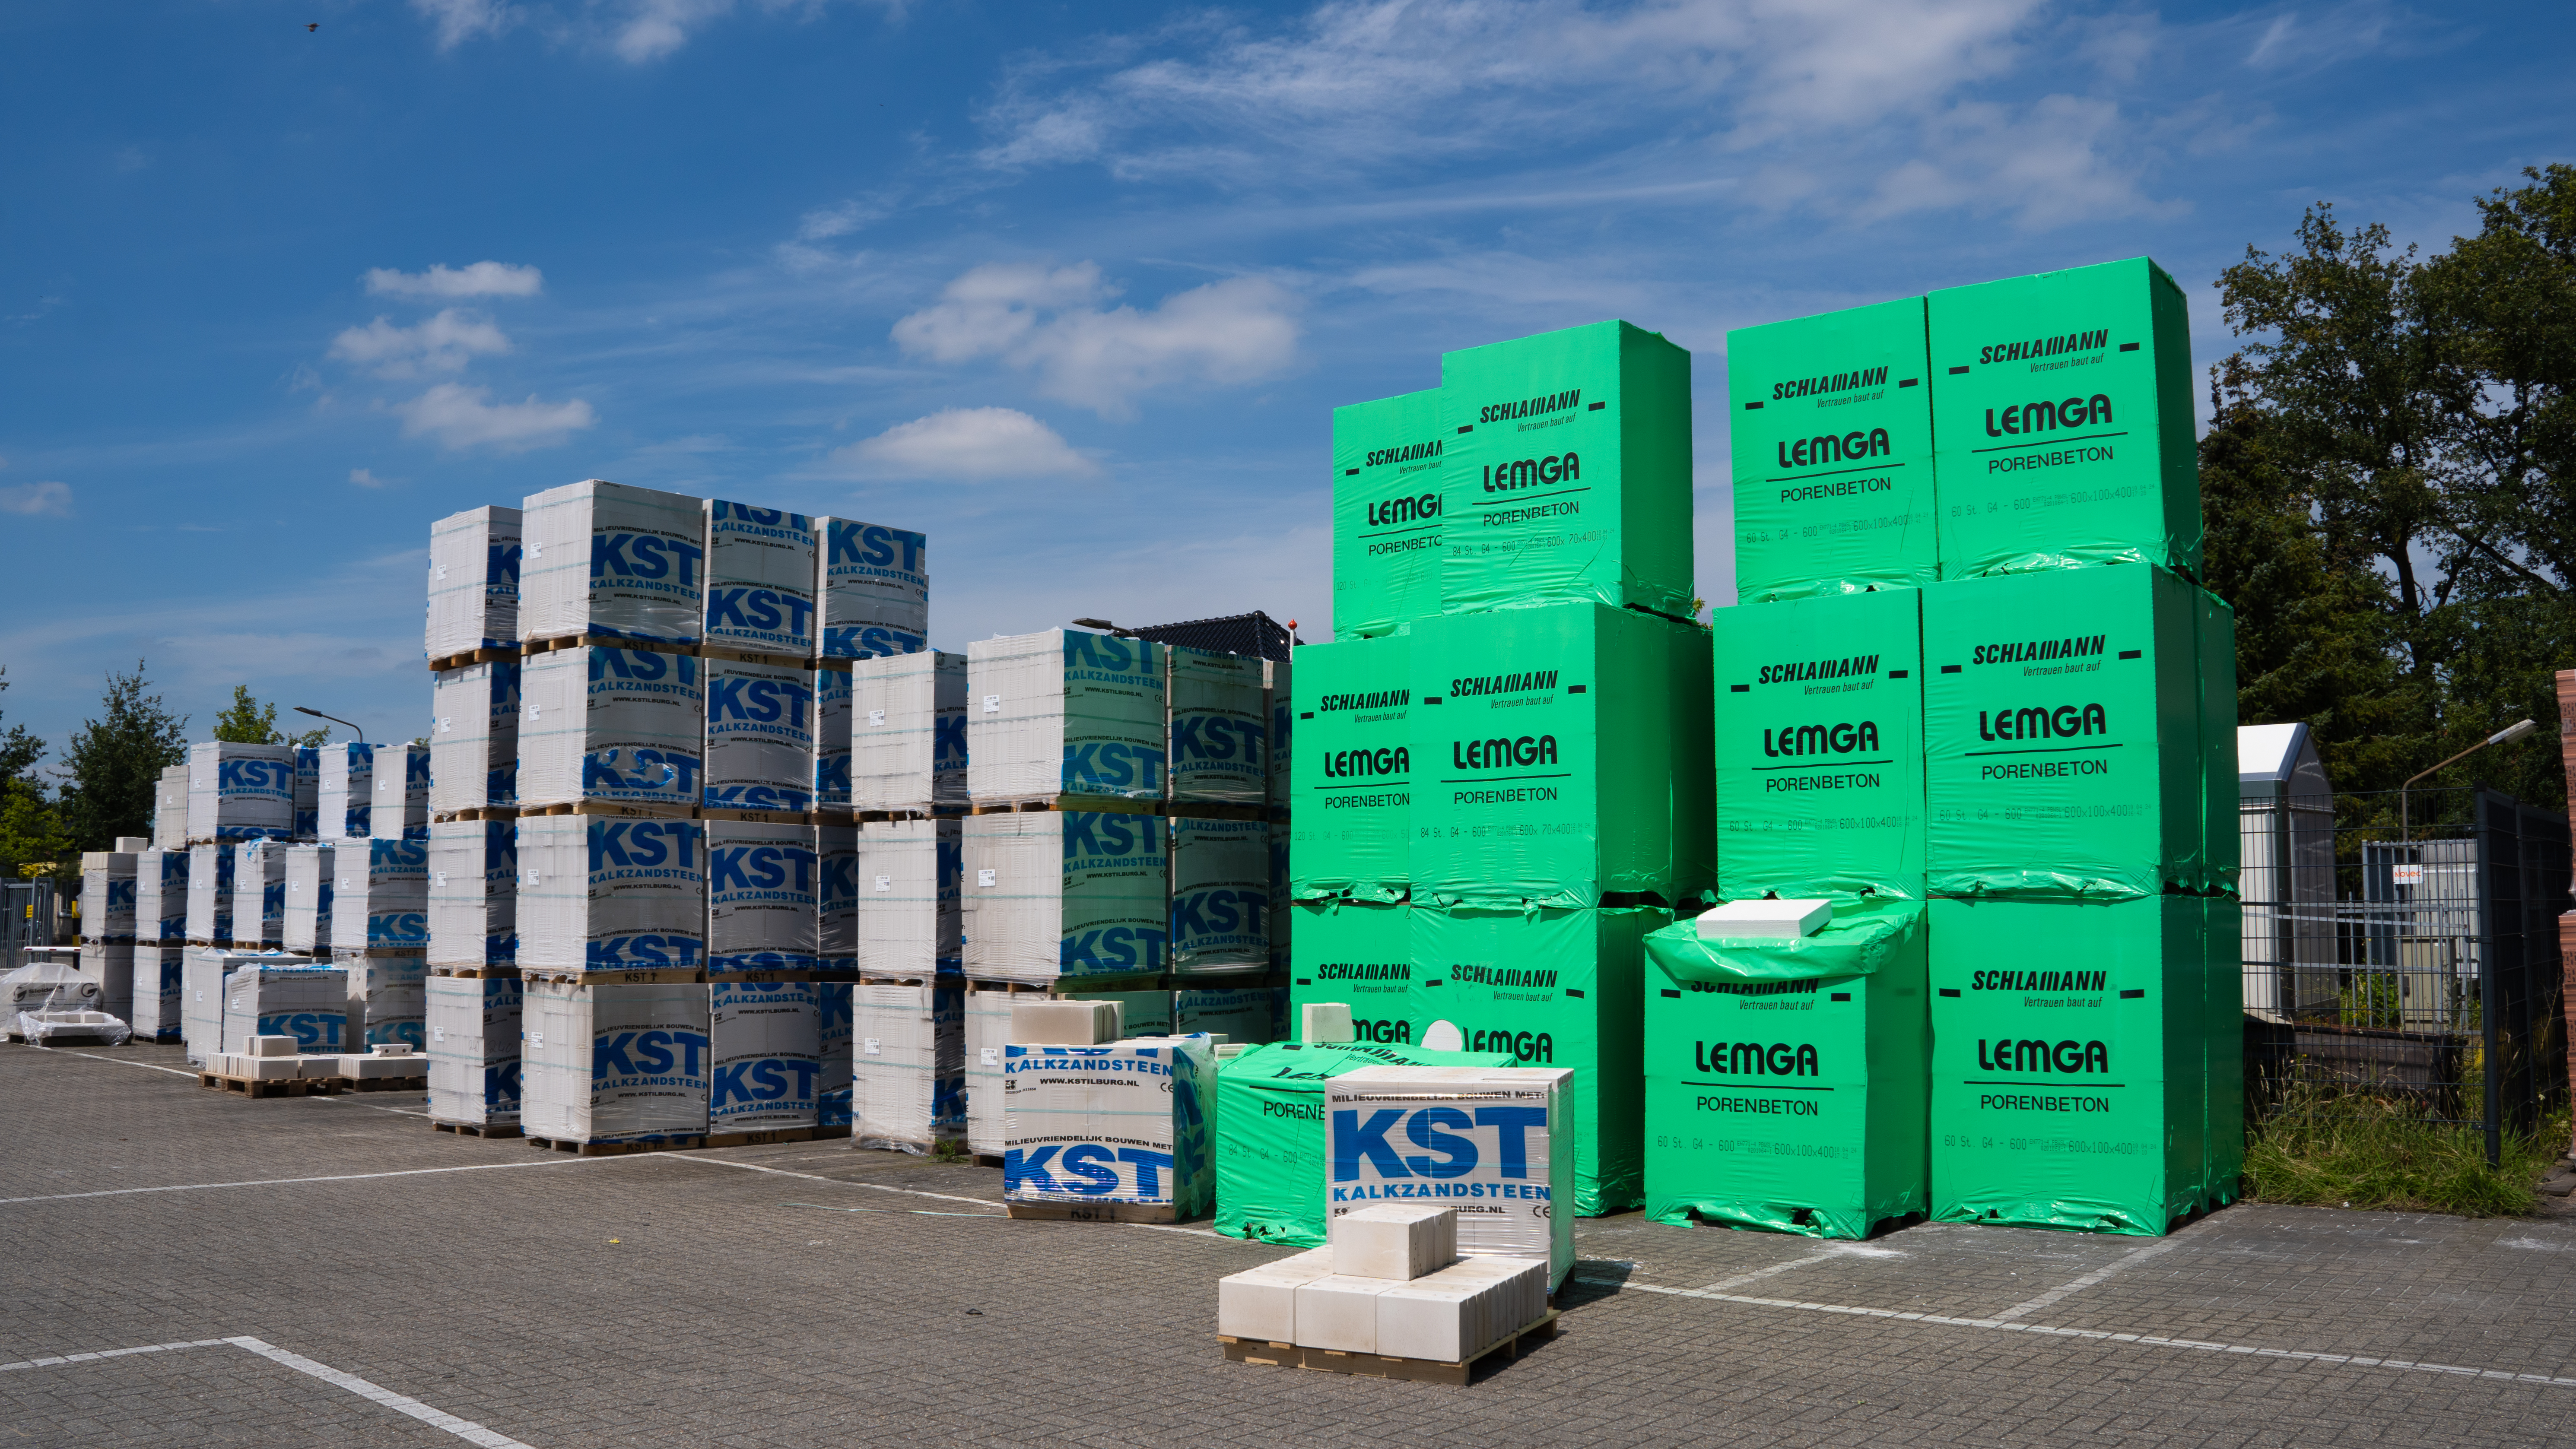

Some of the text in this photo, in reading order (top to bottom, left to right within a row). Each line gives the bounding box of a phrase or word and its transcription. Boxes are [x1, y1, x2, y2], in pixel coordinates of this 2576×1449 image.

[1979, 329, 2108, 364] SCHLAMANN
[2030, 353, 2105, 373] Vertrauen baut auf
[1772, 366, 1888, 400] SCHLAMANN
[1480, 389, 1580, 423] SCHLAMANN
[1817, 390, 1884, 408] Vertrauen baut auf
[1518, 412, 1576, 432] Vertrauen baut auf
[1986, 394, 2112, 437] LEMGA
[1779, 428, 1890, 468] LEMGA
[1399, 463, 1426, 474] Vertrauen
[1989, 446, 2113, 474] PORENBETON
[1484, 452, 1579, 492] LEMGA
[1781, 477, 1891, 502] PORENBETON
[2071, 487, 2132, 504] 600x100x400
[1484, 501, 1579, 526] PORENBETON
[1952, 498, 2030, 517] 60 St. G4 600
[594, 526, 688, 541] MILIEUVRIENDELIJK BOUWEN
[735, 538, 795, 551] WWW.KSTILBURG.NL
[828, 521, 925, 572] KST
[1453, 547, 1461, 556] 84
[591, 534, 701, 587] KST
[827, 566, 924, 587] KALKZANDSTEEN
[848, 580, 904, 590] WWW.KSTILBURG.NL
[589, 579, 701, 600] KALKZANDSTEEN
[614, 593, 682, 605] WWW.KSTILBURG.NL
[706, 589, 813, 636] KST
[886, 623, 909, 632] BOUWEN
[1972, 634, 2106, 665] SCHLAMANN
[1193, 660, 1244, 670] WWW.KSTILBURG.NL
[1759, 654, 1879, 684] SCHLAMANN
[2023, 660, 2101, 677] Vertrauen baut auf
[1064, 670, 1163, 691] KALKZANDSTEEN
[1451, 670, 1558, 697] SCHLAMANN
[1804, 679, 1874, 695] Vertrauen baut auf
[588, 682, 702, 701] KALKZANDSTEEN
[1085, 687, 1143, 698] WWW.KSTILBURG.NL
[1321, 689, 1410, 712] SCHLAMANN
[1491, 694, 1554, 709] Vertrauen baut auf
[613, 697, 681, 707] WWW.KSTILBURG.NL
[709, 678, 812, 729] KST
[1355, 710, 1407, 723] Vertrauen baut auf
[1980, 703, 2106, 741] LEMGA
[708, 723, 812, 742] KALKZANDSTEEN
[731, 737, 793, 747] WWW.KSTILBURG.NL
[1172, 717, 1264, 764] KST
[1764, 721, 1879, 757] LEMGA
[658, 744, 686, 752] BOUWEN
[1454, 735, 1558, 769] LEMGA
[1063, 743, 1164, 789] KST
[1325, 747, 1409, 777] LEMGA
[1982, 759, 2107, 780] PORENBETON
[219, 760, 293, 790] KST
[1766, 774, 1880, 793] PORENBETON
[1325, 793, 1410, 809] PORENBETON
[1455, 787, 1557, 804] PORENBETON
[1064, 811, 1166, 859] KST
[588, 821, 702, 872] KST
[711, 847, 816, 893] KST
[1064, 857, 1166, 873] KALKZANDSTEEN
[589, 869, 703, 885] KALKZANDSTEEN
[1173, 890, 1269, 942] KST
[1062, 918, 1126, 935] MILIEUVRIENDELIJK
[1061, 927, 1166, 972] KST
[1353, 984, 1407, 993] Vertrauen baut auf
[1691, 978, 1819, 994] SCHLAMANN
[1972, 970, 2106, 991] SCHLAMANN
[1493, 991, 1553, 1002] Vertrauen baut auf
[1740, 1000, 1814, 1010] Vertrauen baut auf
[2024, 996, 2102, 1007] Vertrauen baut auf
[259, 1014, 346, 1044] KST
[595, 1024, 664, 1035] MILIEUVRIENDELIJK
[592, 1031, 707, 1080] KST
[1696, 1041, 1818, 1076] LEMGA
[1979, 1039, 2108, 1073] LEMGA
[1005, 1059, 1173, 1076] KALKZANDSTEEN
[711, 1059, 819, 1108] KST
[1040, 1078, 1139, 1086] WWW.KSTILBURG.NL
[1332, 1093, 1454, 1103] MILIEUVRIENDELIJK
[1457, 1091, 1511, 1100] BOUWEN
[1697, 1097, 1818, 1116] PORENBETON
[1981, 1095, 2109, 1112] PORENBETON
[1005, 1135, 1102, 1146] MILIEUVRIENDELIJK
[1105, 1137, 1150, 1147] BOUWEN
[1333, 1107, 1547, 1182] KST
[1229, 1145, 1297, 1164] 84 G4 600
[1004, 1144, 1173, 1197] KST
[1334, 1183, 1550, 1202] KALKZANDSTEEN
